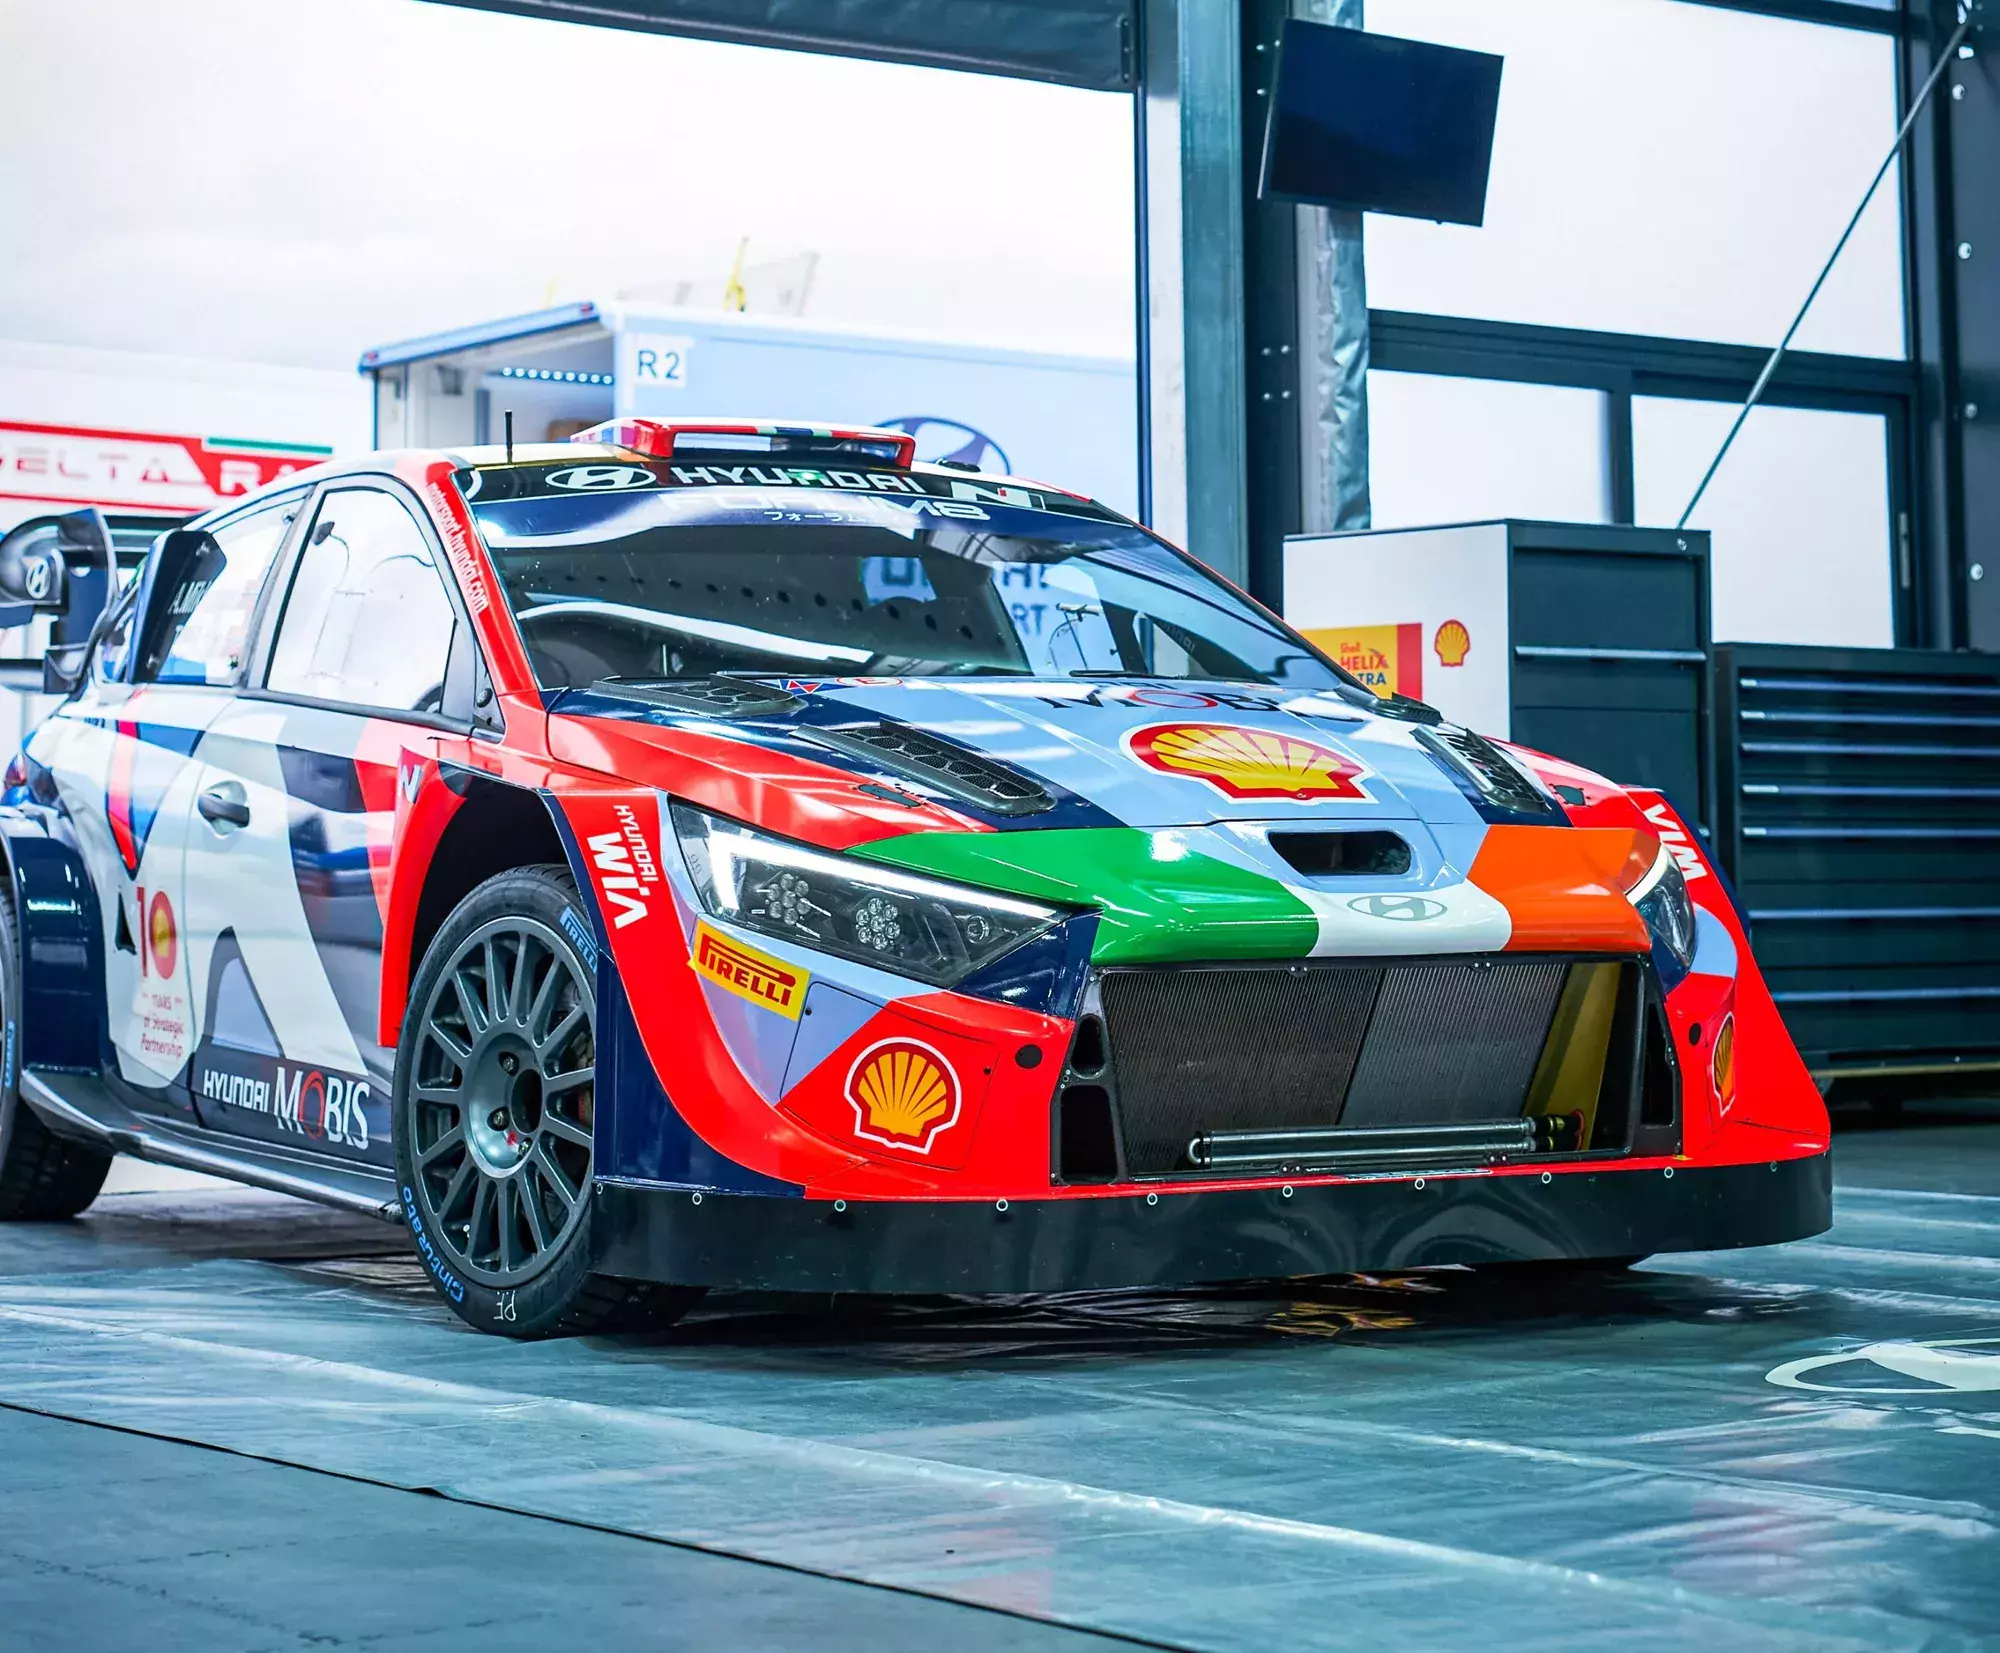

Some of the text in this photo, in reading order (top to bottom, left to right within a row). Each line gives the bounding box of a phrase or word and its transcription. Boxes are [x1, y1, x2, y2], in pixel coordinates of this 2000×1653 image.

[637, 349, 680, 380] R2
[0, 447, 190, 486] ELTA
[670, 466, 927, 494] HYUNDAI
[613, 804, 659, 882] HYUNDAI
[586, 832, 651, 930] WIA
[698, 932, 797, 1007] PIRELLI
[203, 1066, 371, 1151] HYUNDAI MOBIS
